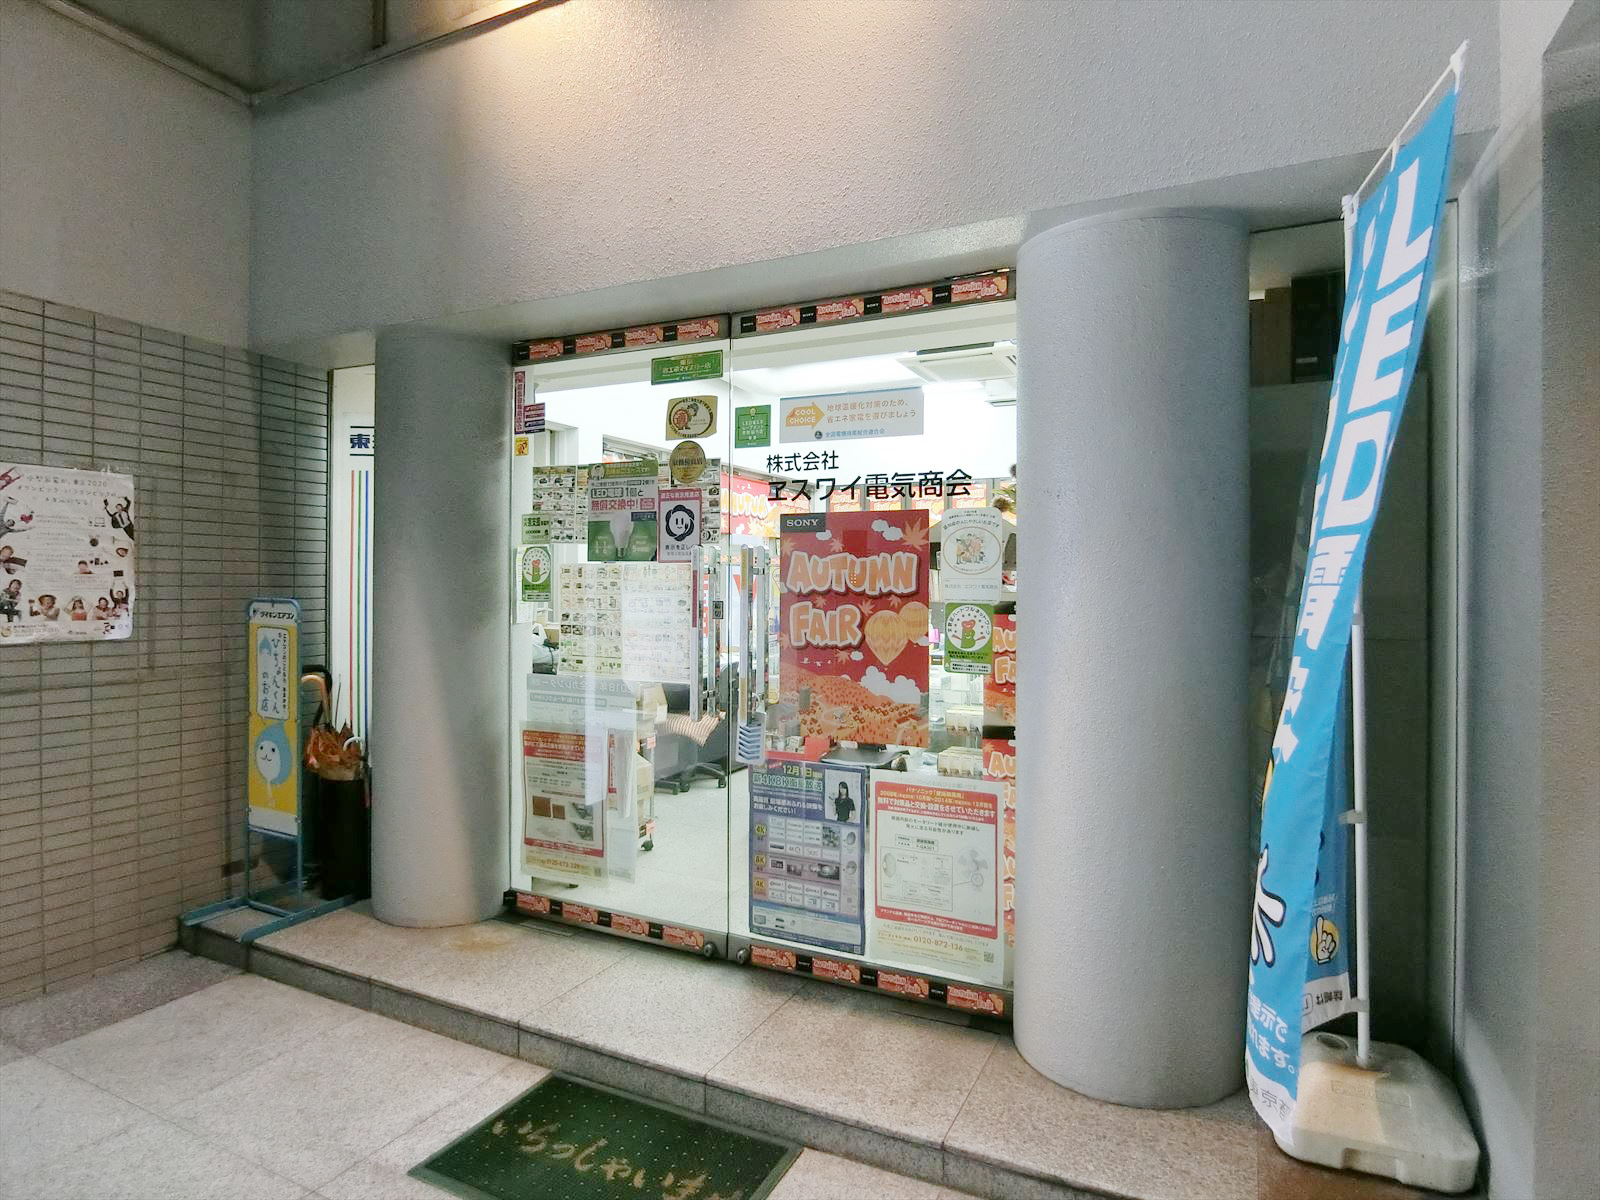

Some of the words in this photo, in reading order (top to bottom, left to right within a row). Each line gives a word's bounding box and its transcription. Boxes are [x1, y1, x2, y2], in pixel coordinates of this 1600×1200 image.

[789, 414, 817, 424] CHOICE
[795, 408, 816, 418] COOL
[767, 450, 839, 473] 株式会社
[787, 517, 820, 528] SONY
[786, 550, 919, 597] AUTUMN
[789, 601, 863, 649] FAIR
